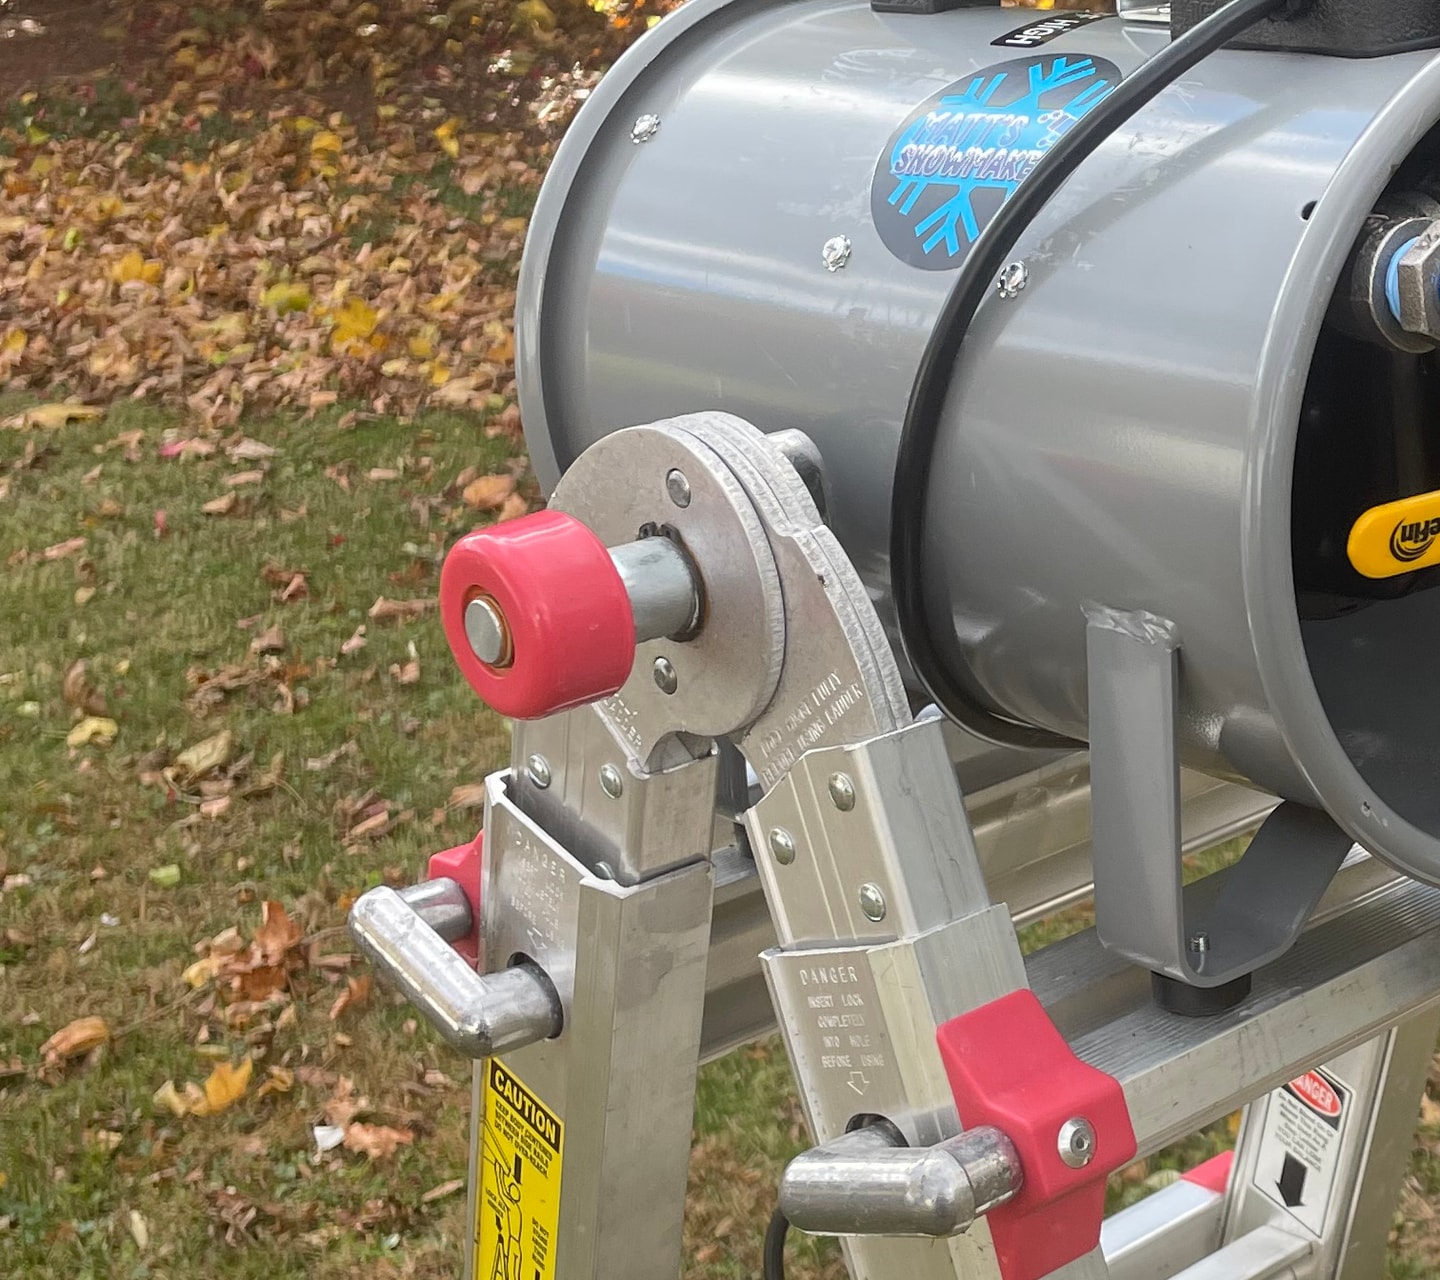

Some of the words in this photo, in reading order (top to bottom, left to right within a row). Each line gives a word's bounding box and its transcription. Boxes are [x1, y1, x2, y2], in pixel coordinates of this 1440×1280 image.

[1005, 19, 1080, 45] HIGH
[911, 111, 1029, 147] MATT'S
[894, 143, 1042, 180] SNOWMAKE
[800, 966, 858, 985] DANGER
[495, 1070, 556, 1144] CAUTION
